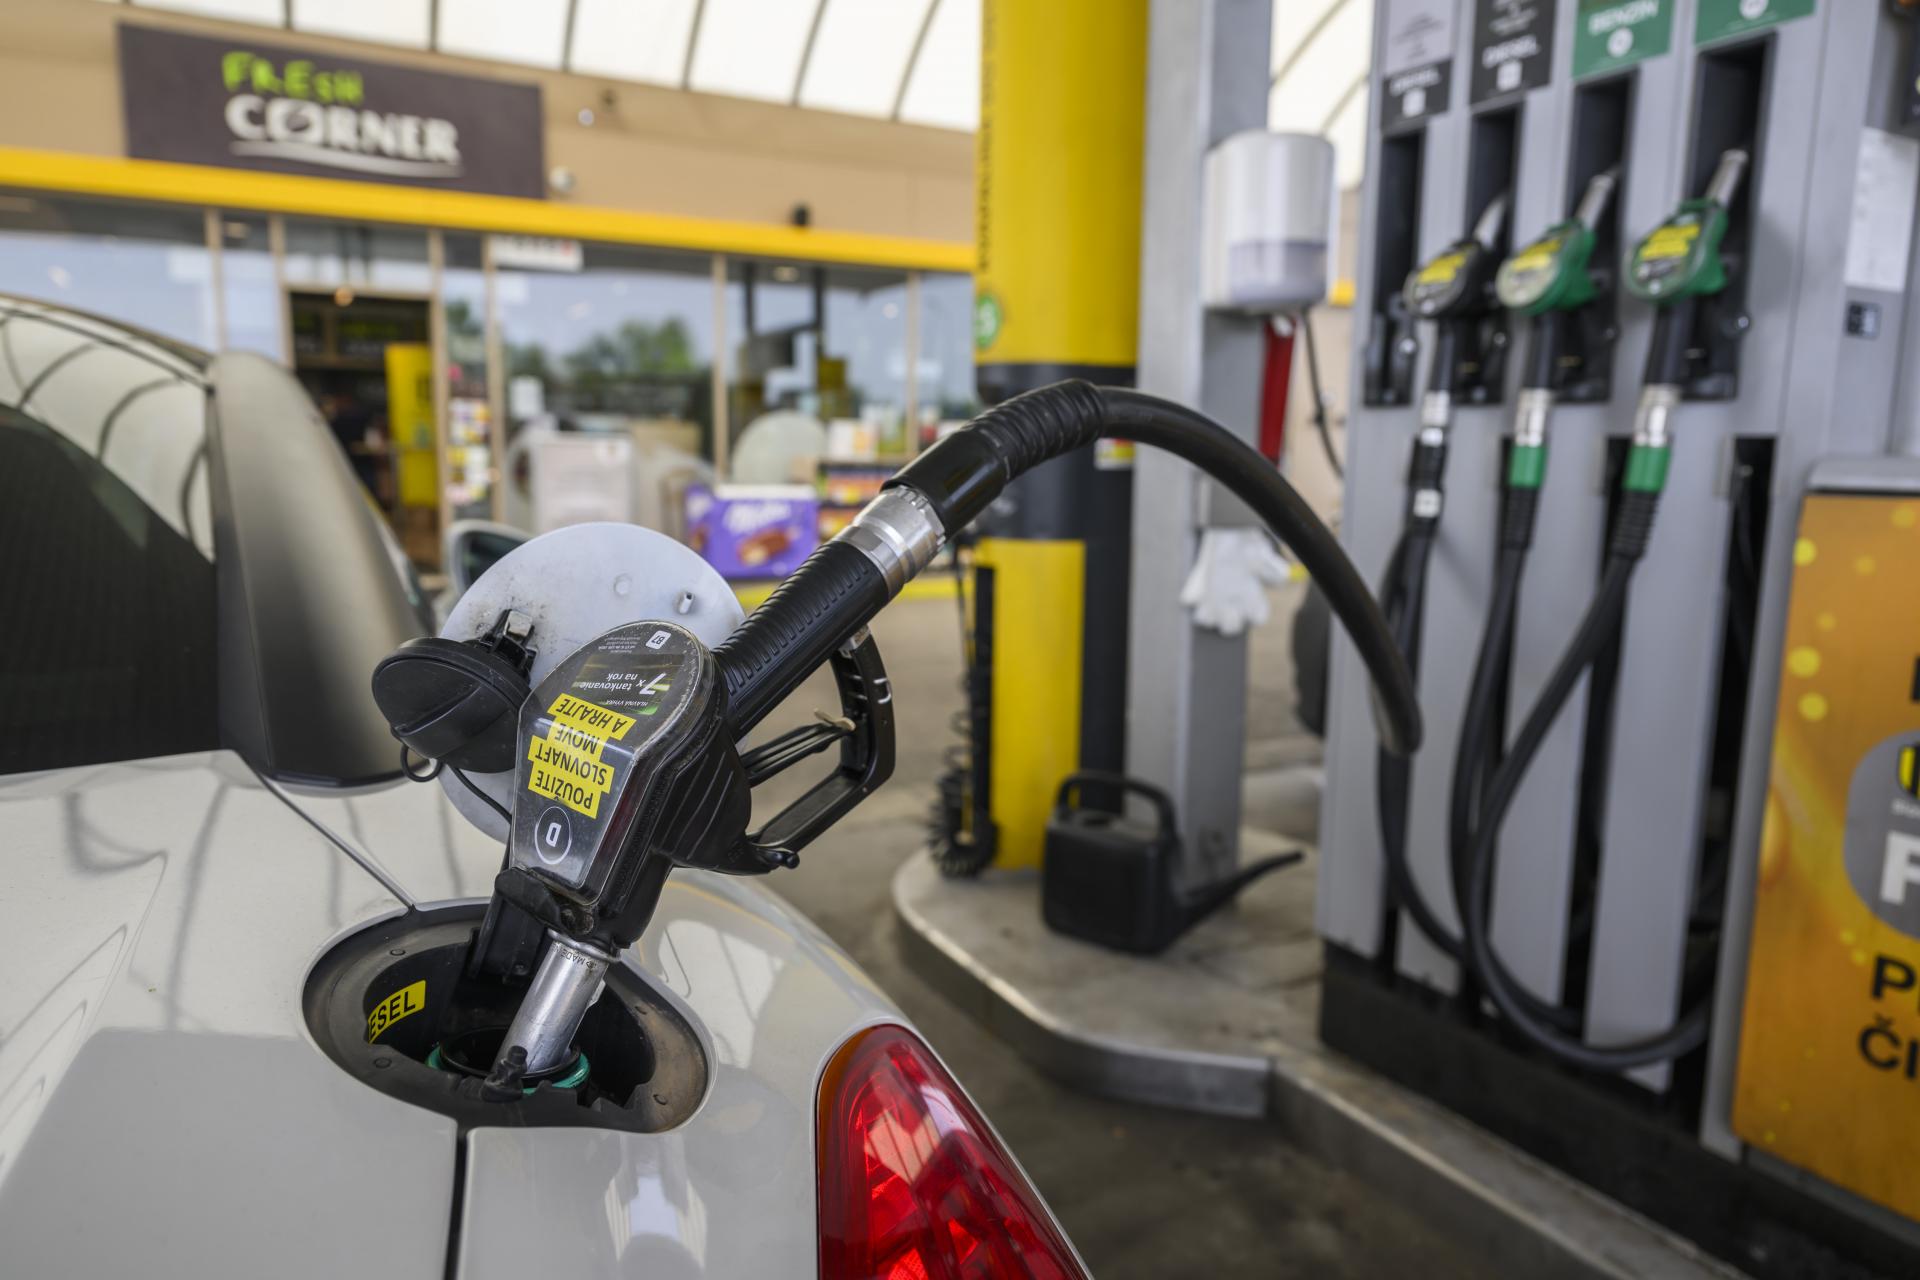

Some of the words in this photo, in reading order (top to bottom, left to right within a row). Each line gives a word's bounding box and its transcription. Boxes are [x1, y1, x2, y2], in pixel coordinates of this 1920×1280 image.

[222, 51, 364, 105] FRESH
[225, 94, 462, 166] CORNER
[651, 635, 665, 645] B7
[579, 681, 632, 691] tankovanie
[606, 673, 624, 681] rok
[639, 672, 667, 695] 7
[556, 698, 613, 729] HRAJTE
[611, 720, 628, 733] A
[554, 723, 600, 755] MOVE
[535, 743, 607, 786] SLOVNAFT
[534, 770, 594, 810] POUŽITE
[545, 822, 562, 848] D
[1872, 954, 1920, 1014] P
